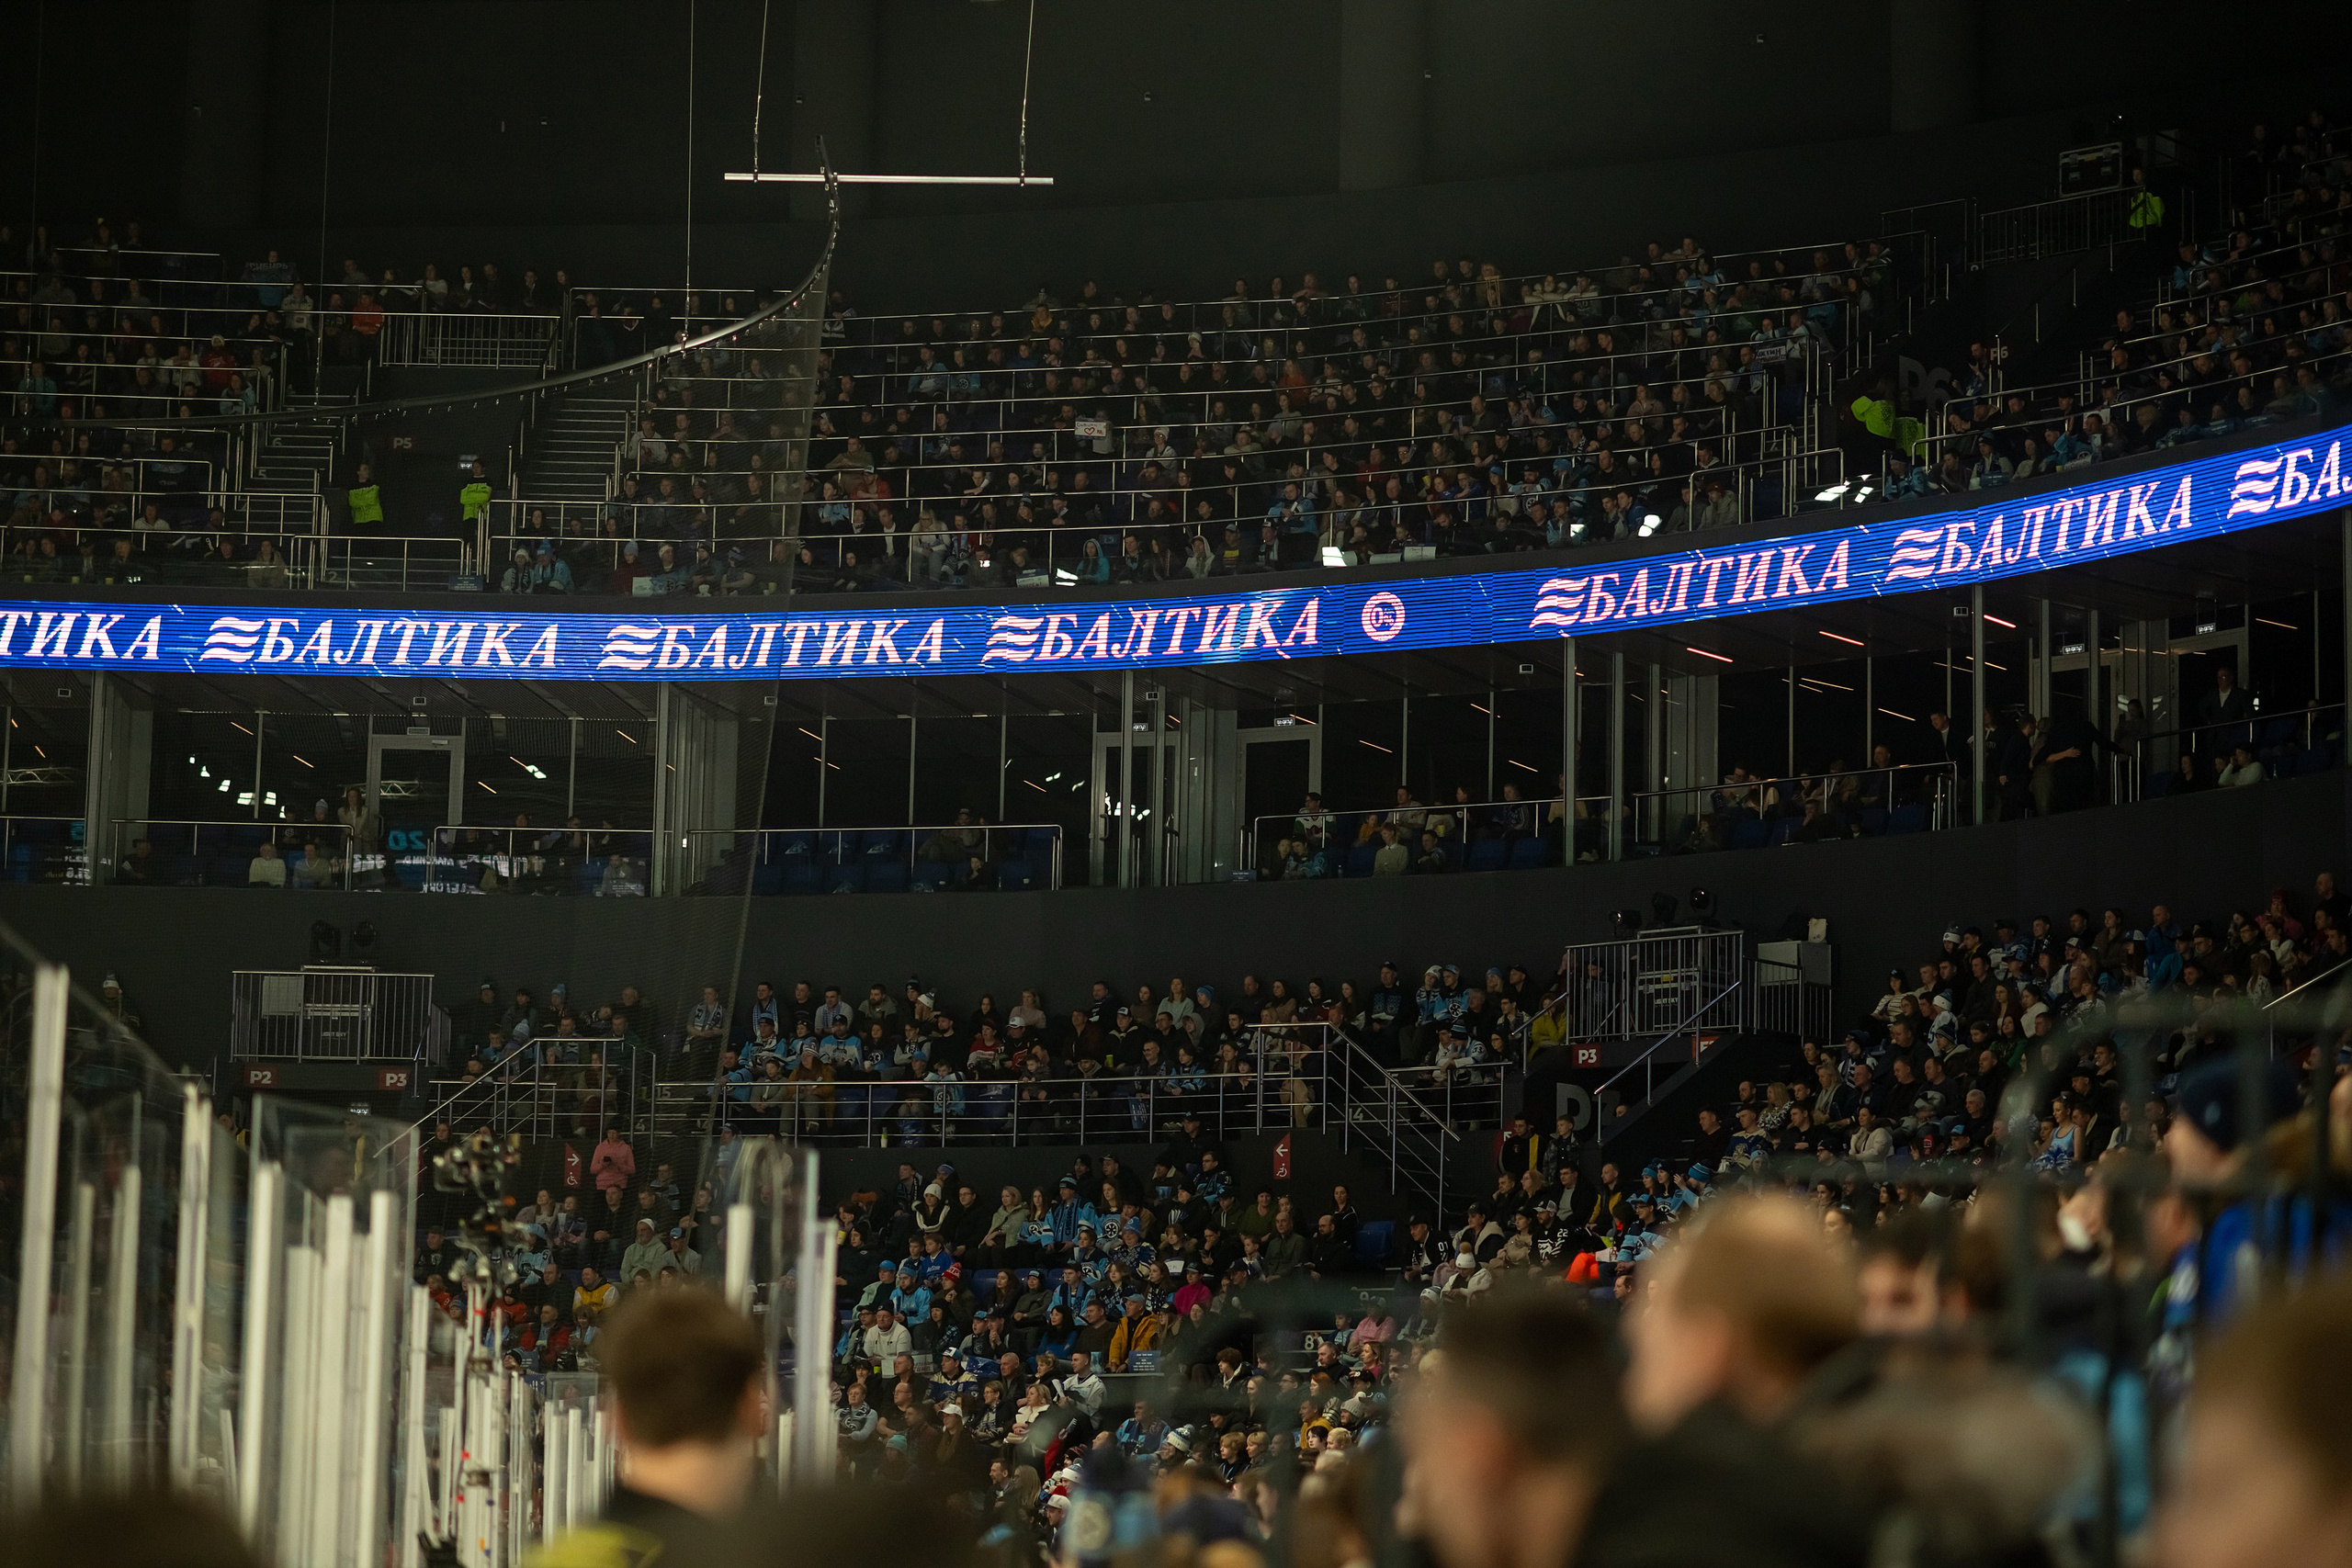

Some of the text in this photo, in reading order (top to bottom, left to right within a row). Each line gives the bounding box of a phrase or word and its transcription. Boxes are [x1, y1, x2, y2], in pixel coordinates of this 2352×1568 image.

[392, 437, 413, 449] P5
[2274, 440, 2352, 509] БА
[1935, 475, 2193, 575] БАЛТИКА
[1579, 539, 1849, 623] БАЛТИКА
[255, 618, 559, 669] БАЛТИКА
[655, 618, 946, 670] БАЛТИКА
[1037, 598, 1319, 660] БАЛТИКА
[1578, 1049, 1598, 1064] P3
[250, 1071, 272, 1085] P2
[386, 1073, 407, 1087] P3
[1557, 1228, 1568, 1238] 22
[1304, 1335, 1314, 1350] 8
